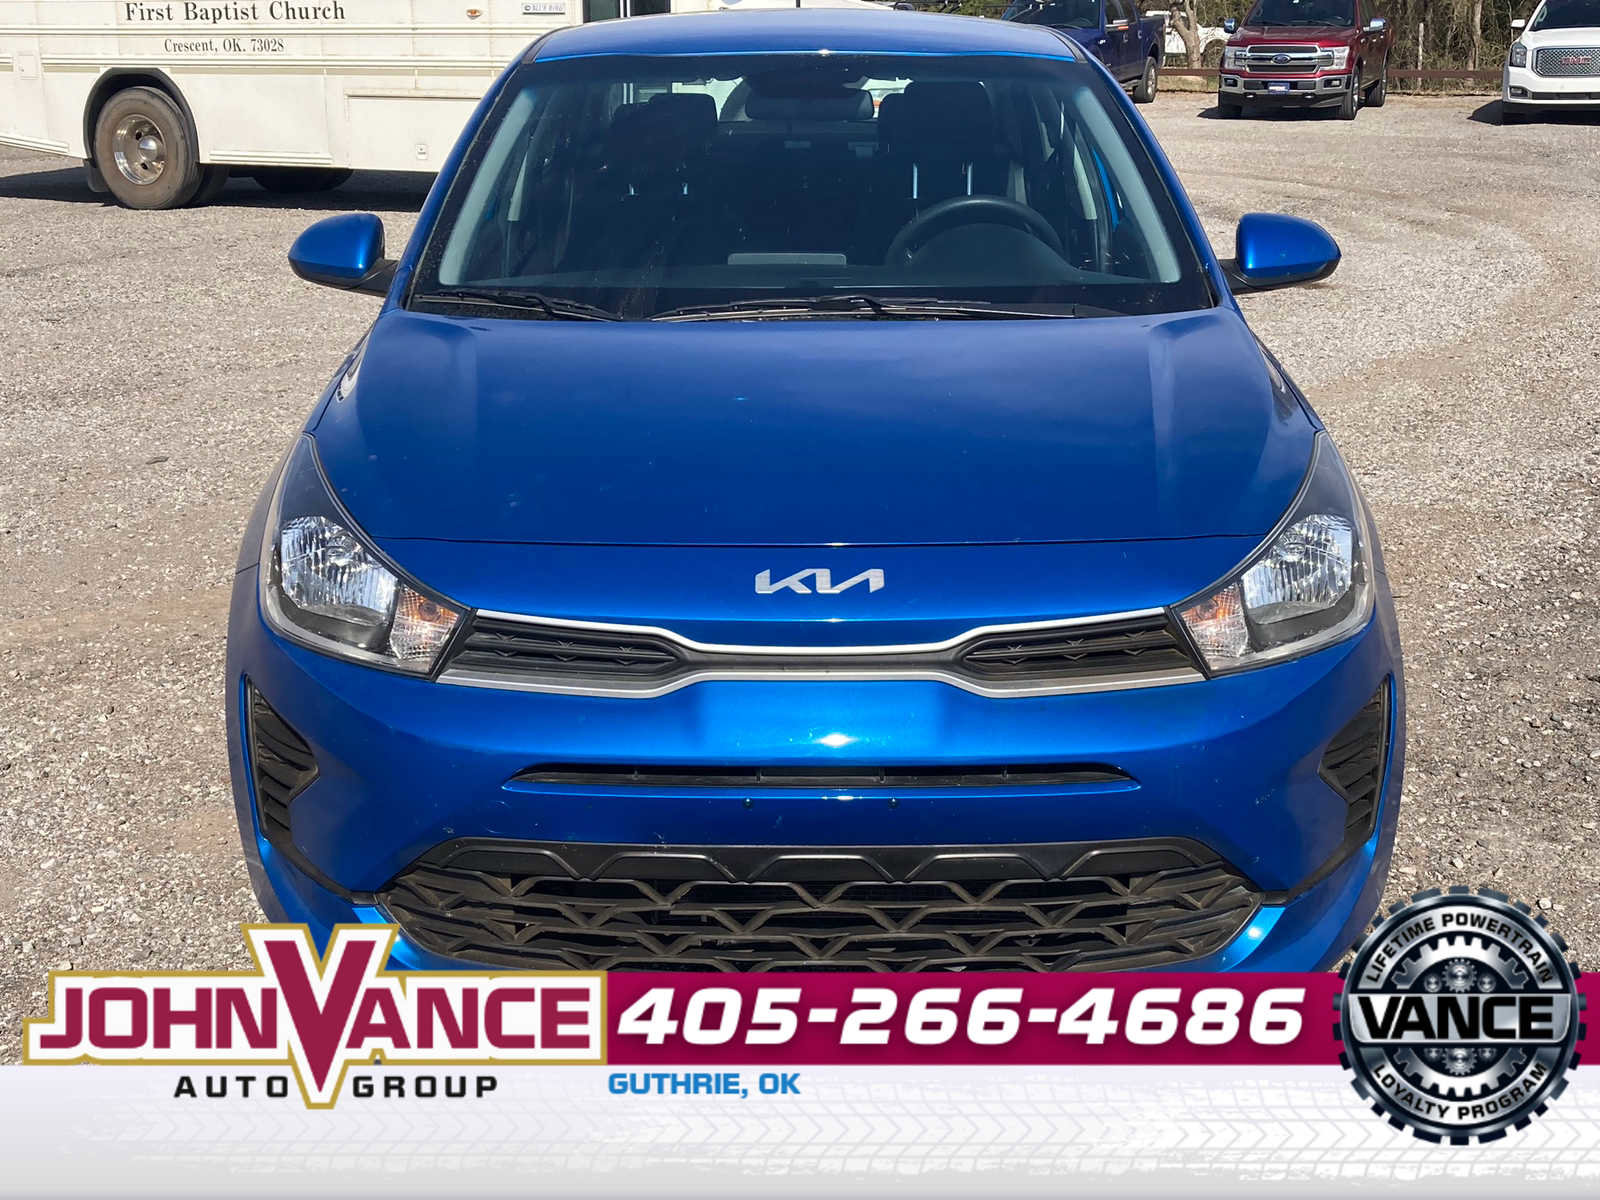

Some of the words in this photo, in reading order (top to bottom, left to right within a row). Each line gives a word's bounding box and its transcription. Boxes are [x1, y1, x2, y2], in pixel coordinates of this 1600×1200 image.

[125, 2, 174, 21] First
[184, 1, 259, 24] Baptist
[269, 1, 345, 20] Church
[164, 38, 218, 53] Crescent,
[223, 39, 246, 52] OK.
[251, 39, 285, 52] 73028
